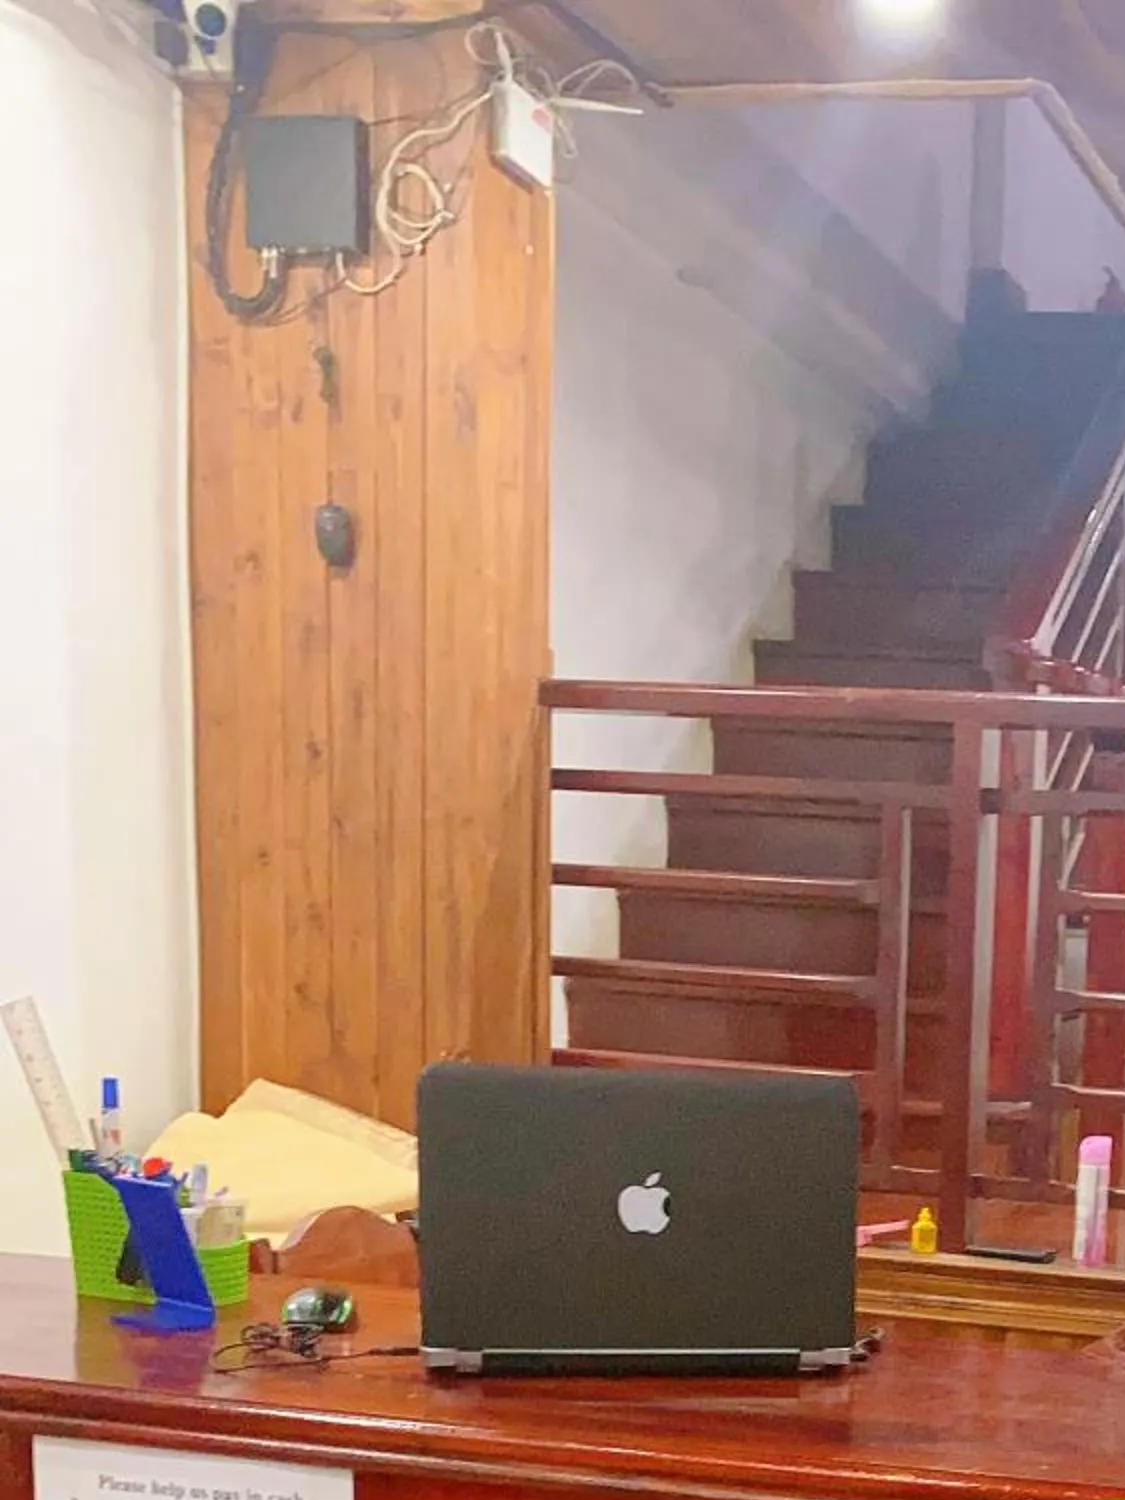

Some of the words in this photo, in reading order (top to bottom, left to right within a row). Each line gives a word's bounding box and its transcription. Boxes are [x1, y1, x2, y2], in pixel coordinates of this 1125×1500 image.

[99, 1474, 146, 1493] Please
[151, 1480, 185, 1500] help
[190, 1487, 208, 1499] us
